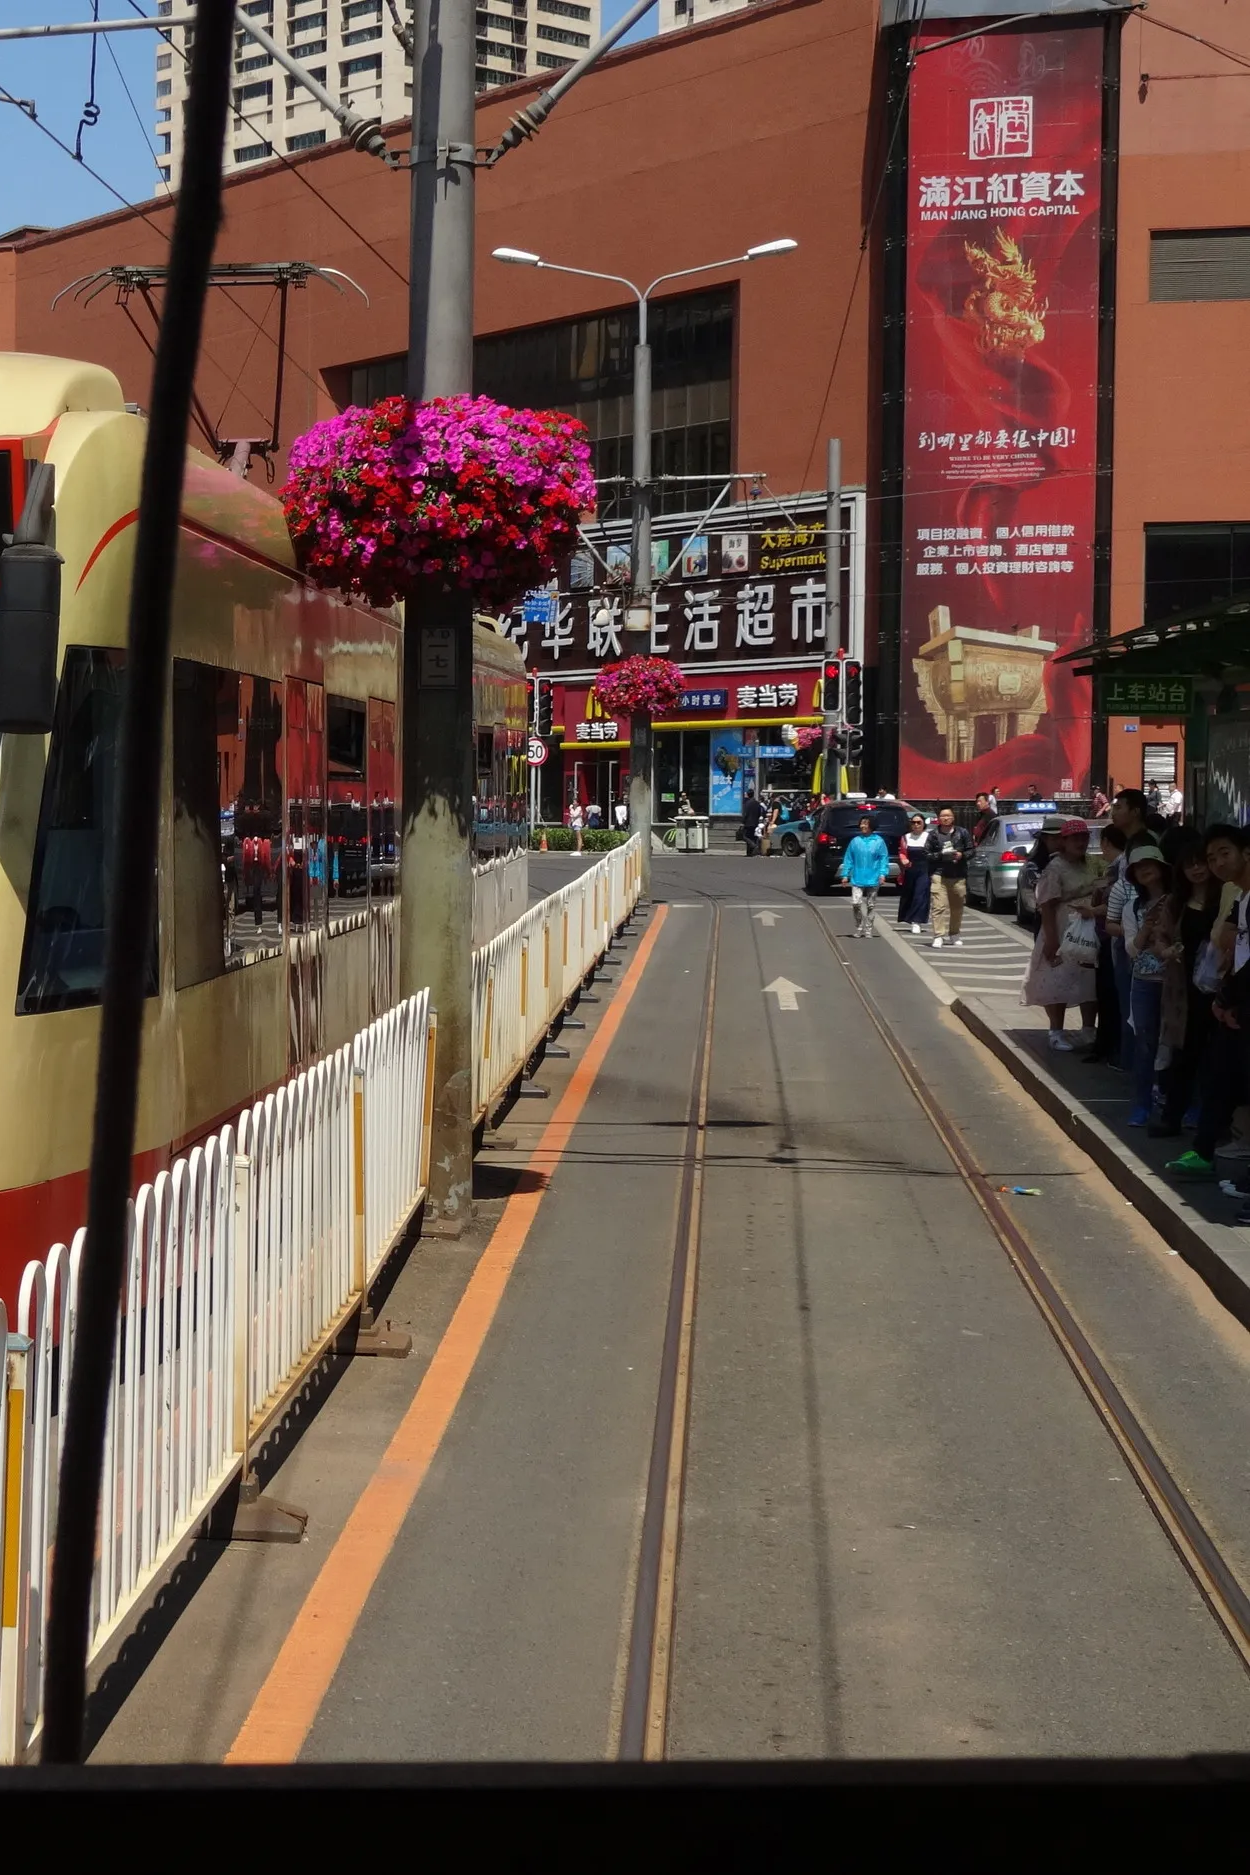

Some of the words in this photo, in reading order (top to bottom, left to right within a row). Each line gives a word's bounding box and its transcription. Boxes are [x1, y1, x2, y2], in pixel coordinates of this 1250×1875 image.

[919, 170, 1085, 207] 滿江紅資本
[921, 210, 948, 221] MAN
[951, 209, 987, 220] JIANG
[990, 206, 1026, 218] HONG
[1028, 205, 1079, 216] CAPITAL
[736, 684, 798, 709] 麦当劳
[1107, 682, 1186, 702] 上车站台
[575, 722, 618, 741] 麦当劳
